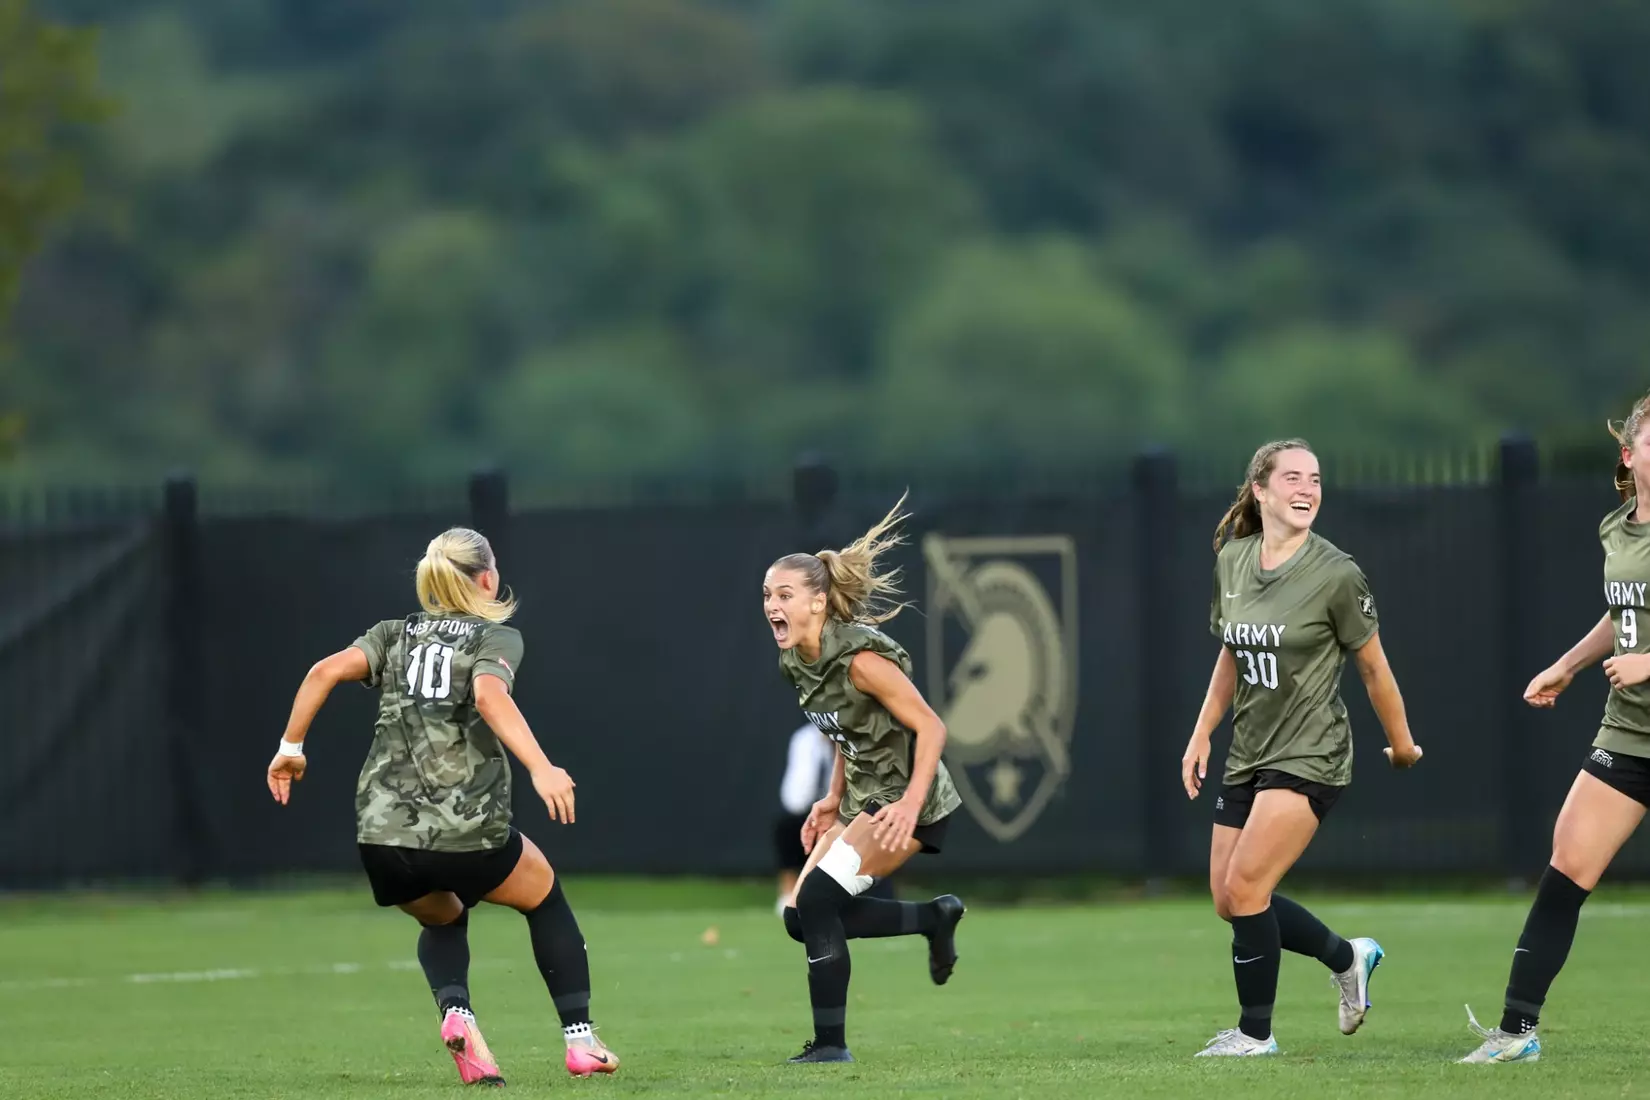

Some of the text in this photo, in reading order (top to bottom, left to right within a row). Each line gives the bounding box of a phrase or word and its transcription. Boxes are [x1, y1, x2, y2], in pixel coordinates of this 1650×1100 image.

[1223, 621, 1286, 647] ARMY
[1619, 608, 1638, 648] 9
[406, 642, 454, 698] 10
[1236, 650, 1279, 690] 30
